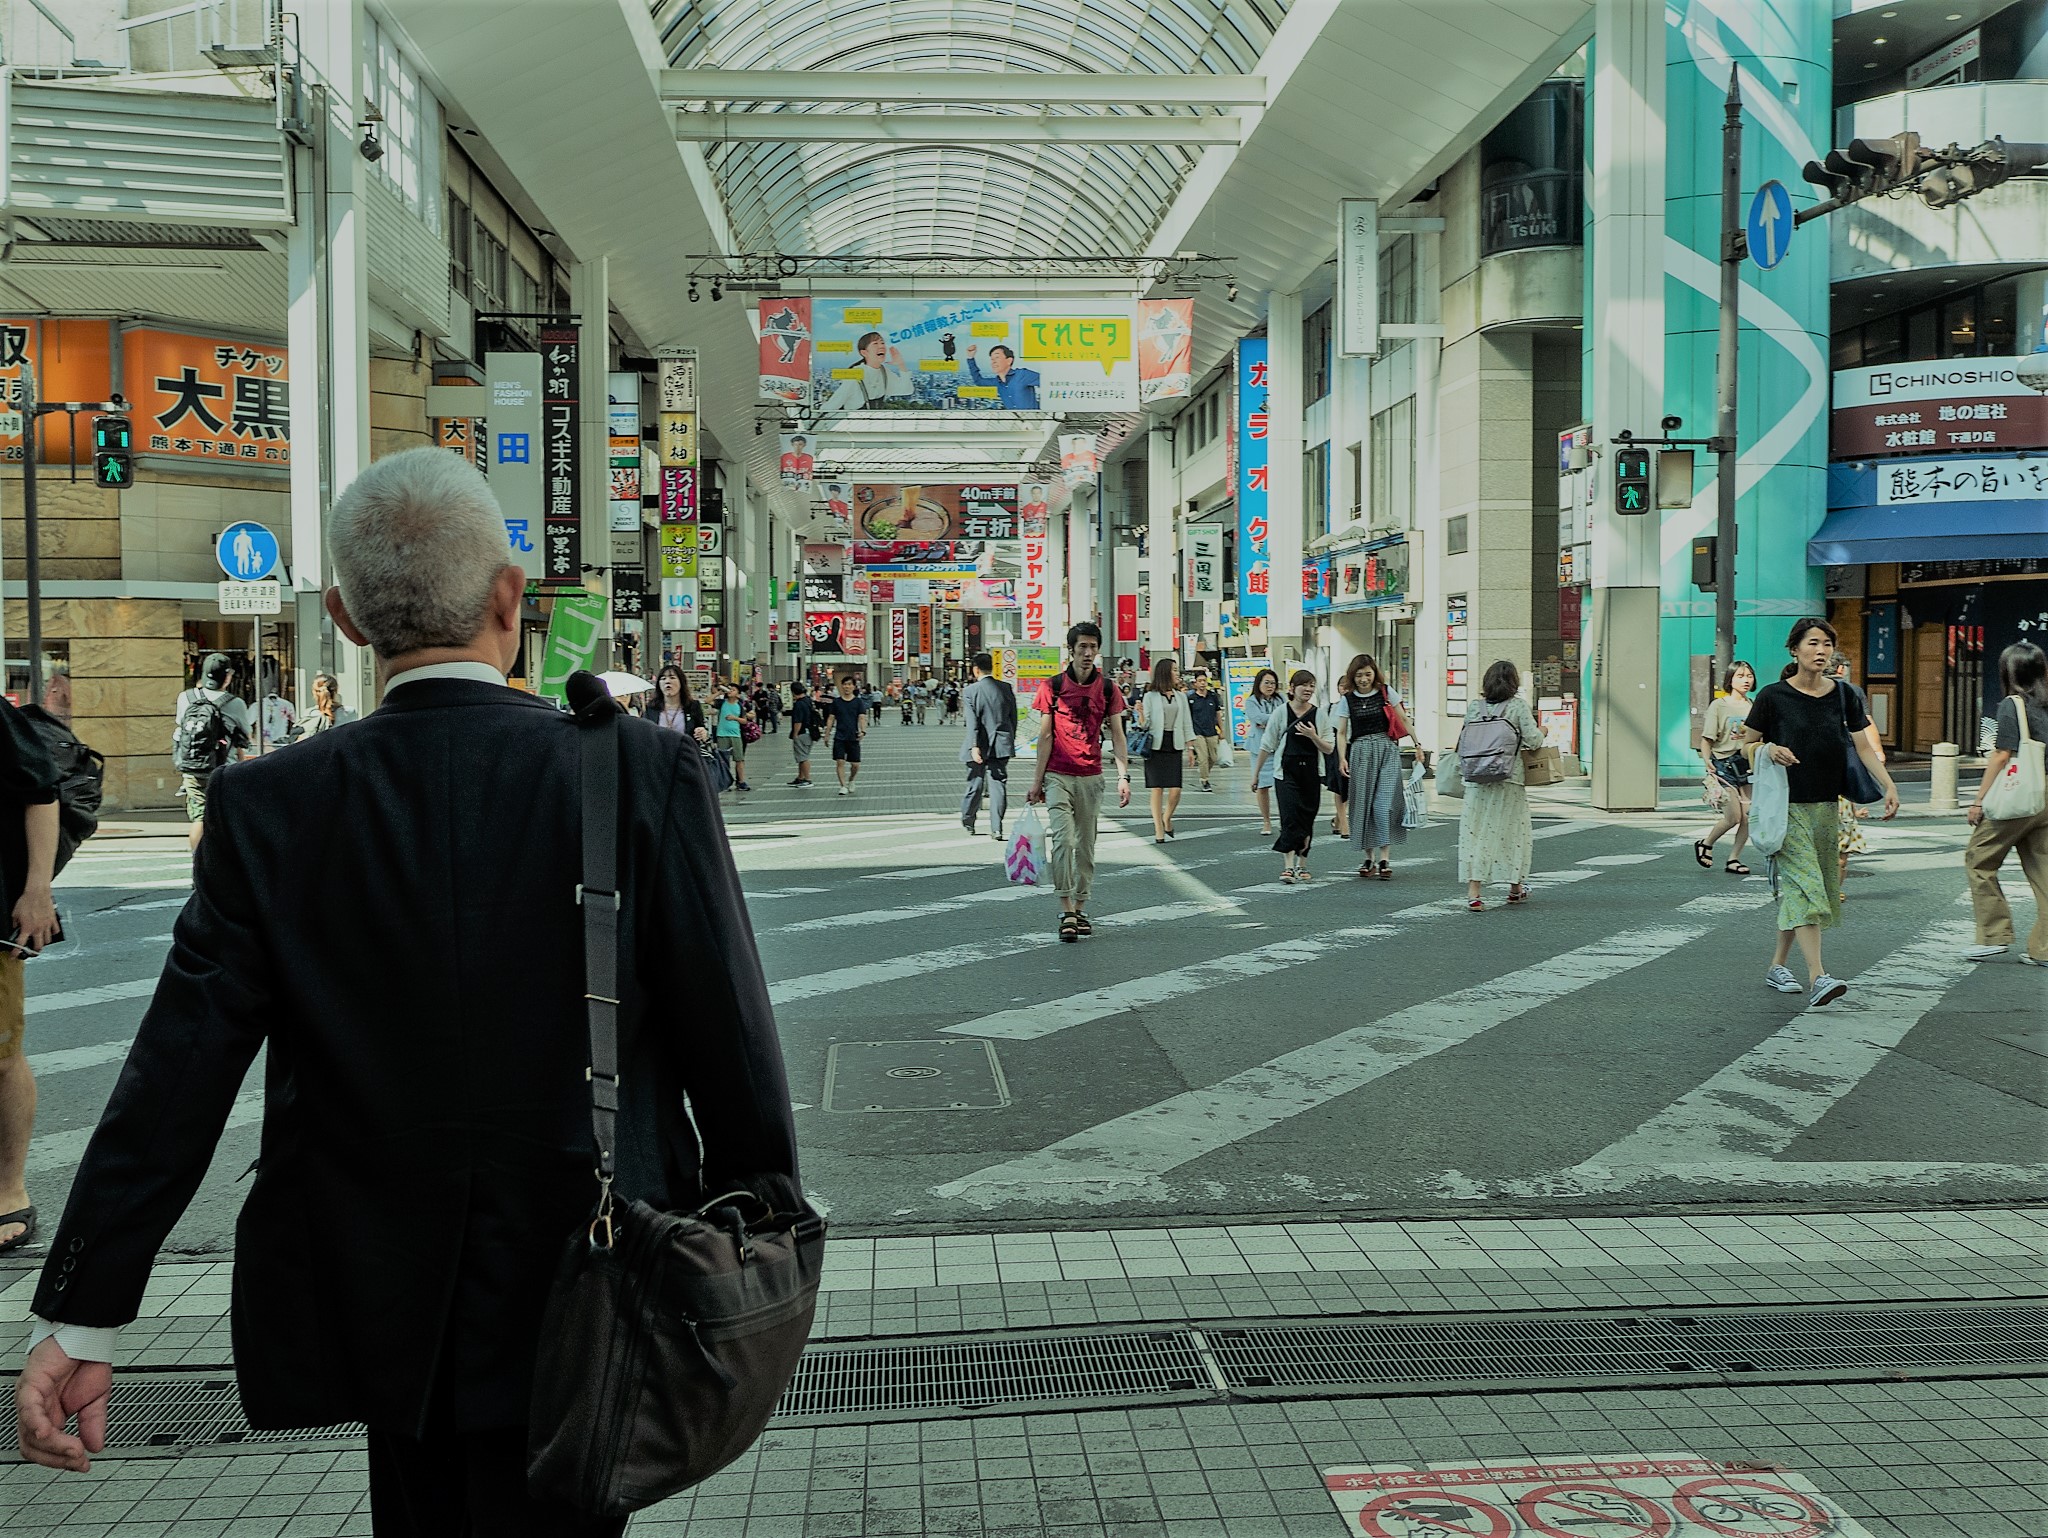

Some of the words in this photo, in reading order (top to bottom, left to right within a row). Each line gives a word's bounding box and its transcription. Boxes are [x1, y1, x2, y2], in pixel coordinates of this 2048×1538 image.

[1509, 220, 1557, 238] Tsuki
[1895, 370, 2014, 389] CHINOSHIO
[494, 398, 525, 406] HOUSE
[1875, 412, 1922, 427] 株式会社
[1938, 403, 2008, 421] 地の塩社
[150, 435, 258, 458] 熊本下通店
[1885, 430, 1936, 448] 水粧館
[1947, 430, 1997, 444] 下通り店
[551, 406, 573, 514] コスギ不動産
[663, 469, 677, 520] ビュッフェ
[678, 469, 694, 520] スイーツ
[960, 486, 1016, 500] 40m手前
[964, 517, 1013, 539] 右折
[669, 594, 693, 609] UQ
[1026, 542, 1046, 641] ジャンカラ
[893, 612, 905, 660] カラオケ
